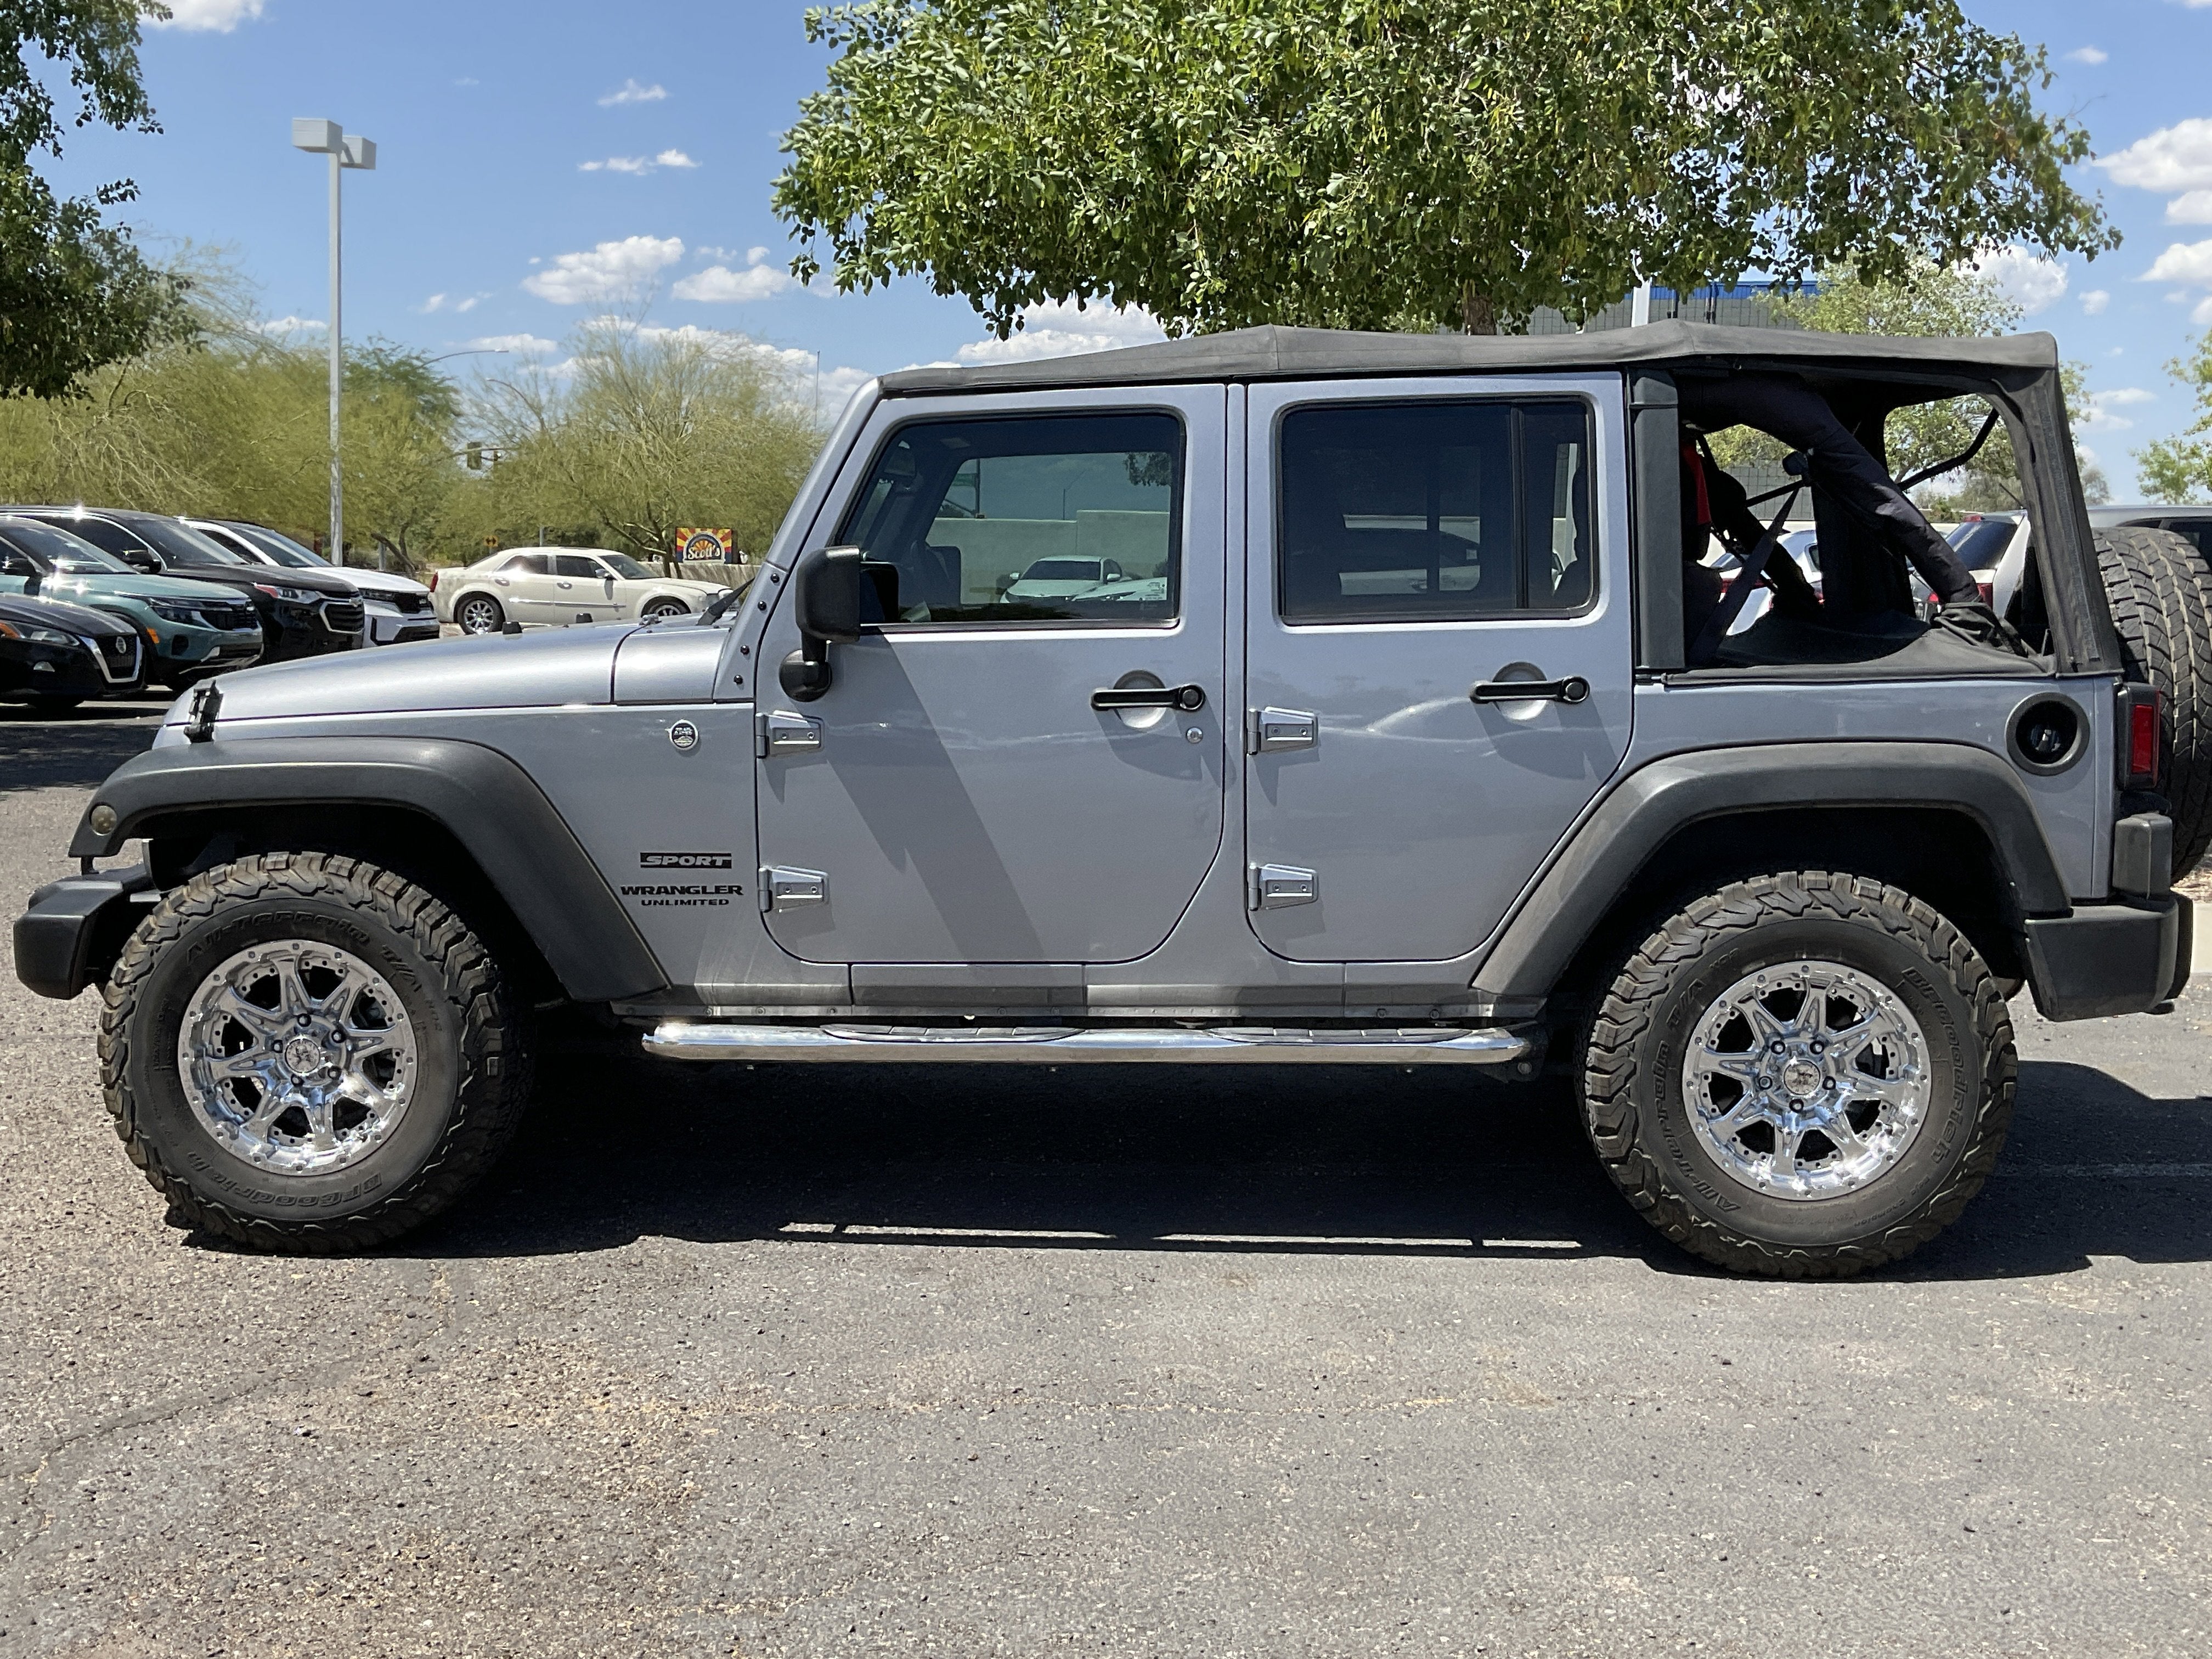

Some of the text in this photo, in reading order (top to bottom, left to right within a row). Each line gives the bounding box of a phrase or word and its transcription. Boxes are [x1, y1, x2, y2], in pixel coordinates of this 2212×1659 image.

[688, 545, 720, 560] Scott's
[640, 854, 732, 867] SPORT
[621, 885, 744, 895] WRANGLER
